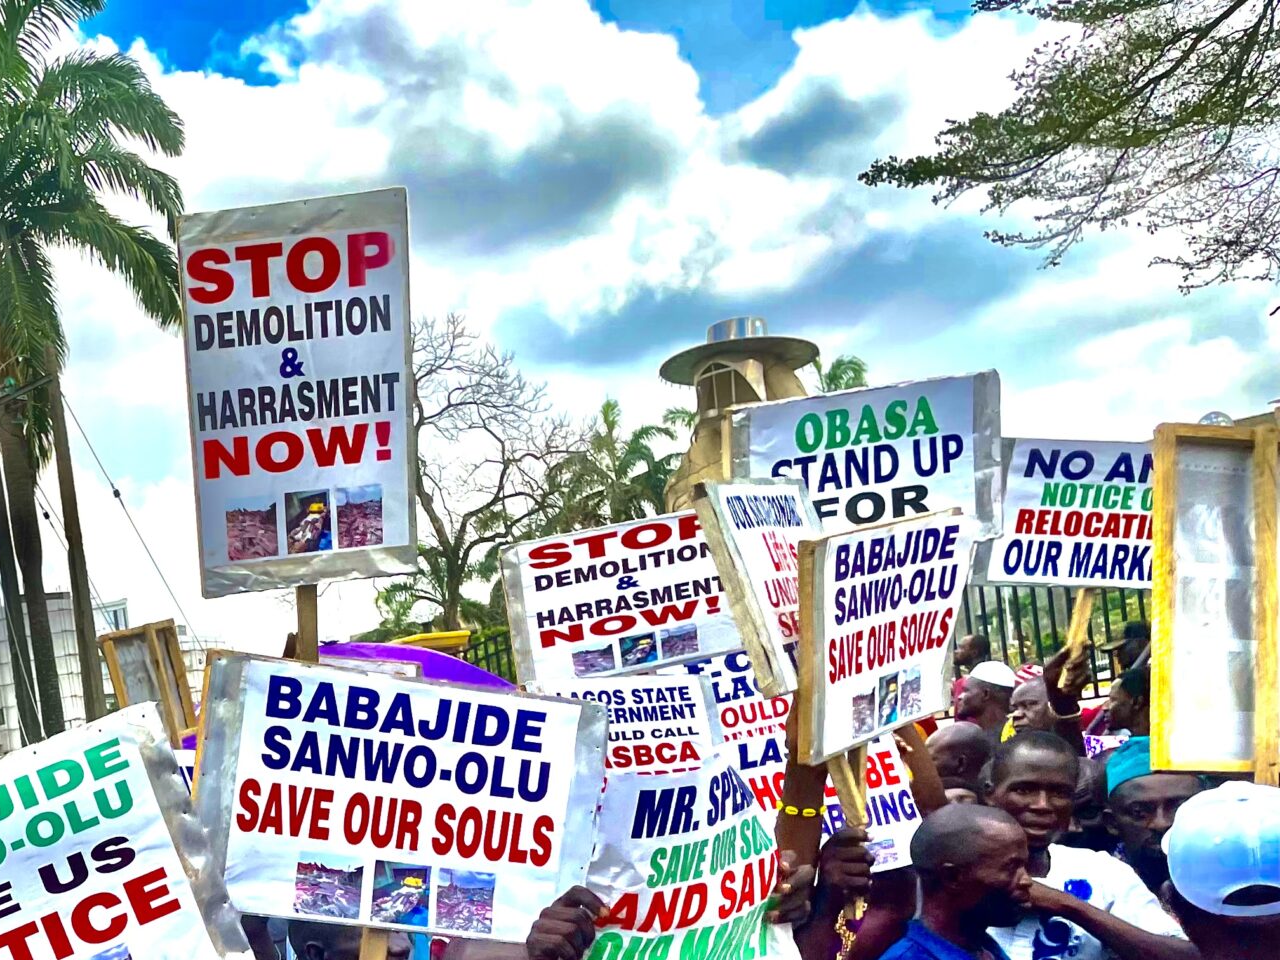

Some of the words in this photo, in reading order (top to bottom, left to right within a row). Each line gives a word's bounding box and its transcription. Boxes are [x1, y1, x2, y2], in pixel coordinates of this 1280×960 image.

[187, 231, 395, 304] STOP
[194, 294, 391, 351] DEMOLITION
[280, 347, 305, 379] &
[197, 372, 400, 432] HARRASMENT
[795, 396, 939, 454] OBASA
[202, 421, 393, 480] NOW!
[912, 433, 964, 478] UP
[1023, 448, 1095, 481] NO
[812, 484, 930, 525] FOR
[1015, 509, 1152, 540] RELOCATI
[1040, 482, 1134, 512] NOTICE
[834, 524, 960, 582] BABAJIDE
[1003, 539, 1062, 577] OUR
[1068, 542, 1152, 582] MARK
[536, 576, 726, 629] HARRASMENT
[616, 575, 640, 591] &
[834, 564, 958, 626] SANWO-OLU
[539, 595, 721, 648] NOW!
[828, 630, 863, 685] SAVE
[867, 620, 896, 671] OUR
[899, 607, 953, 660] SOULS
[265, 674, 548, 753] BABAJIDE
[631, 686, 692, 704] STATE
[650, 726, 699, 739] CALL
[261, 725, 551, 803] SANWO-OLU
[235, 778, 335, 841] SAVE
[343, 792, 423, 852] OUR
[432, 802, 555, 867] SOULS
[631, 785, 699, 839] MR.
[38, 836, 137, 896] US
[646, 838, 709, 888] SAVE
[710, 825, 736, 875] OUR
[594, 882, 707, 932] AND
[718, 849, 780, 919] SAV
